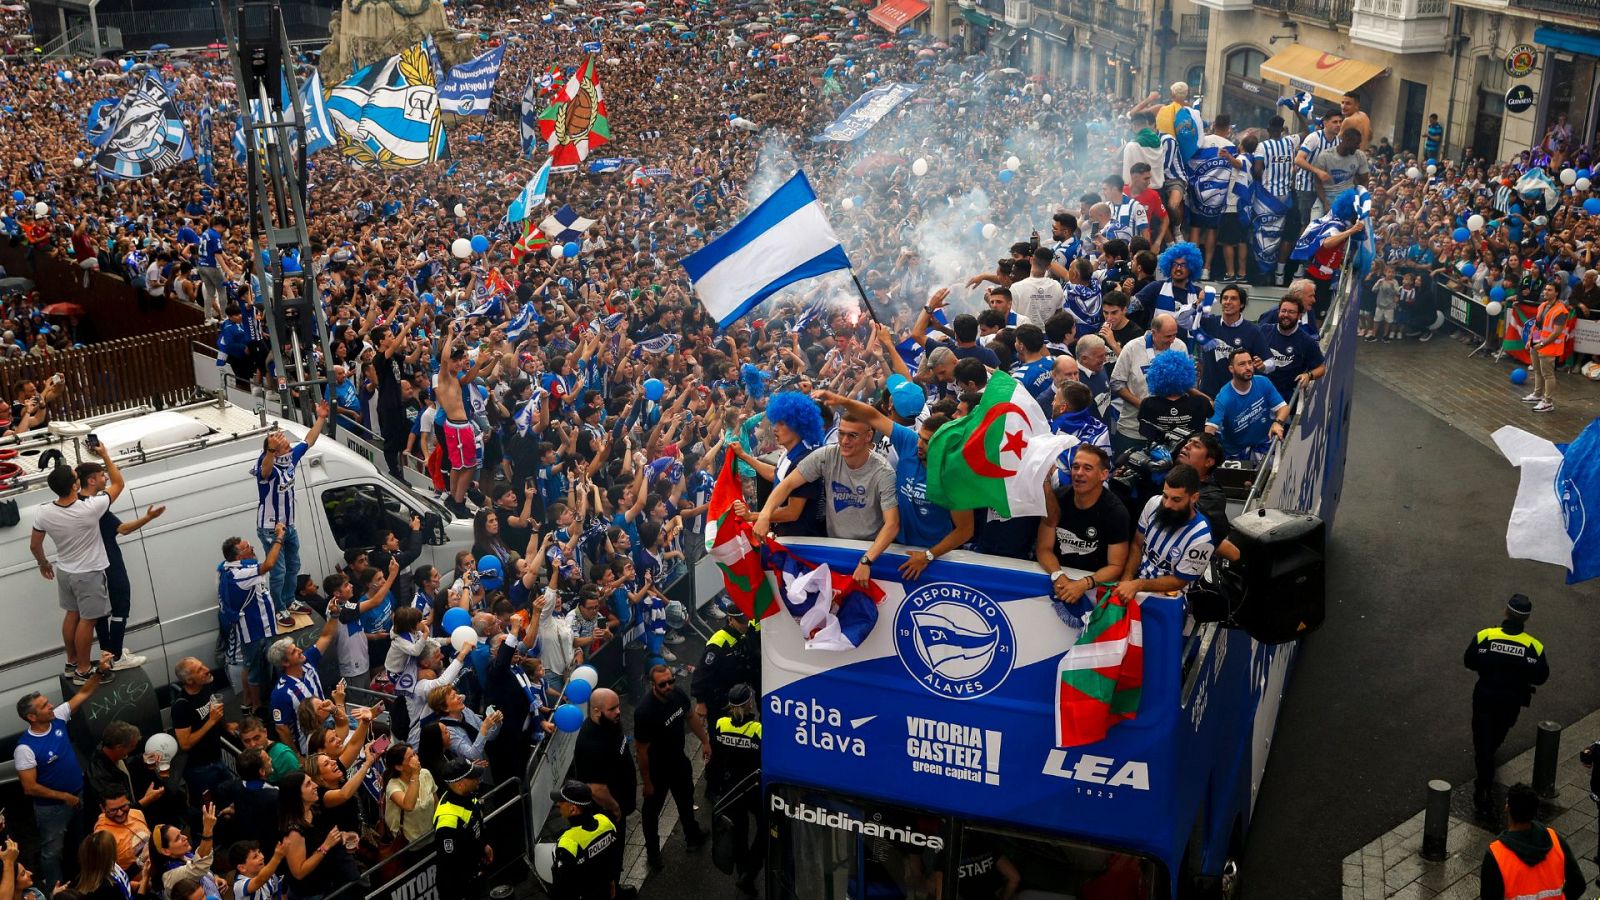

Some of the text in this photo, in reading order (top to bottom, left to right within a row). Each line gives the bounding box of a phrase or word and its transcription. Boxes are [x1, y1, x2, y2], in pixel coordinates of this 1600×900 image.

[1188, 549, 1209, 561] OK
[913, 588, 996, 617] DEPORTIVO
[1000, 645, 1009, 653] 21
[1491, 643, 1525, 656] POLIZIA
[924, 674, 983, 694] ALAVÉS
[770, 695, 841, 727] araba
[795, 721, 866, 757] álava
[906, 716, 983, 749] VITORIA
[906, 738, 982, 769] GASTEIZ
[912, 760, 982, 783] green capital
[1042, 748, 1150, 791] LEA
[771, 794, 944, 851] Publidinamica
[588, 833, 612, 858] POLIZIA
[391, 864, 437, 900] VITOR
[958, 857, 993, 878] STAFF
